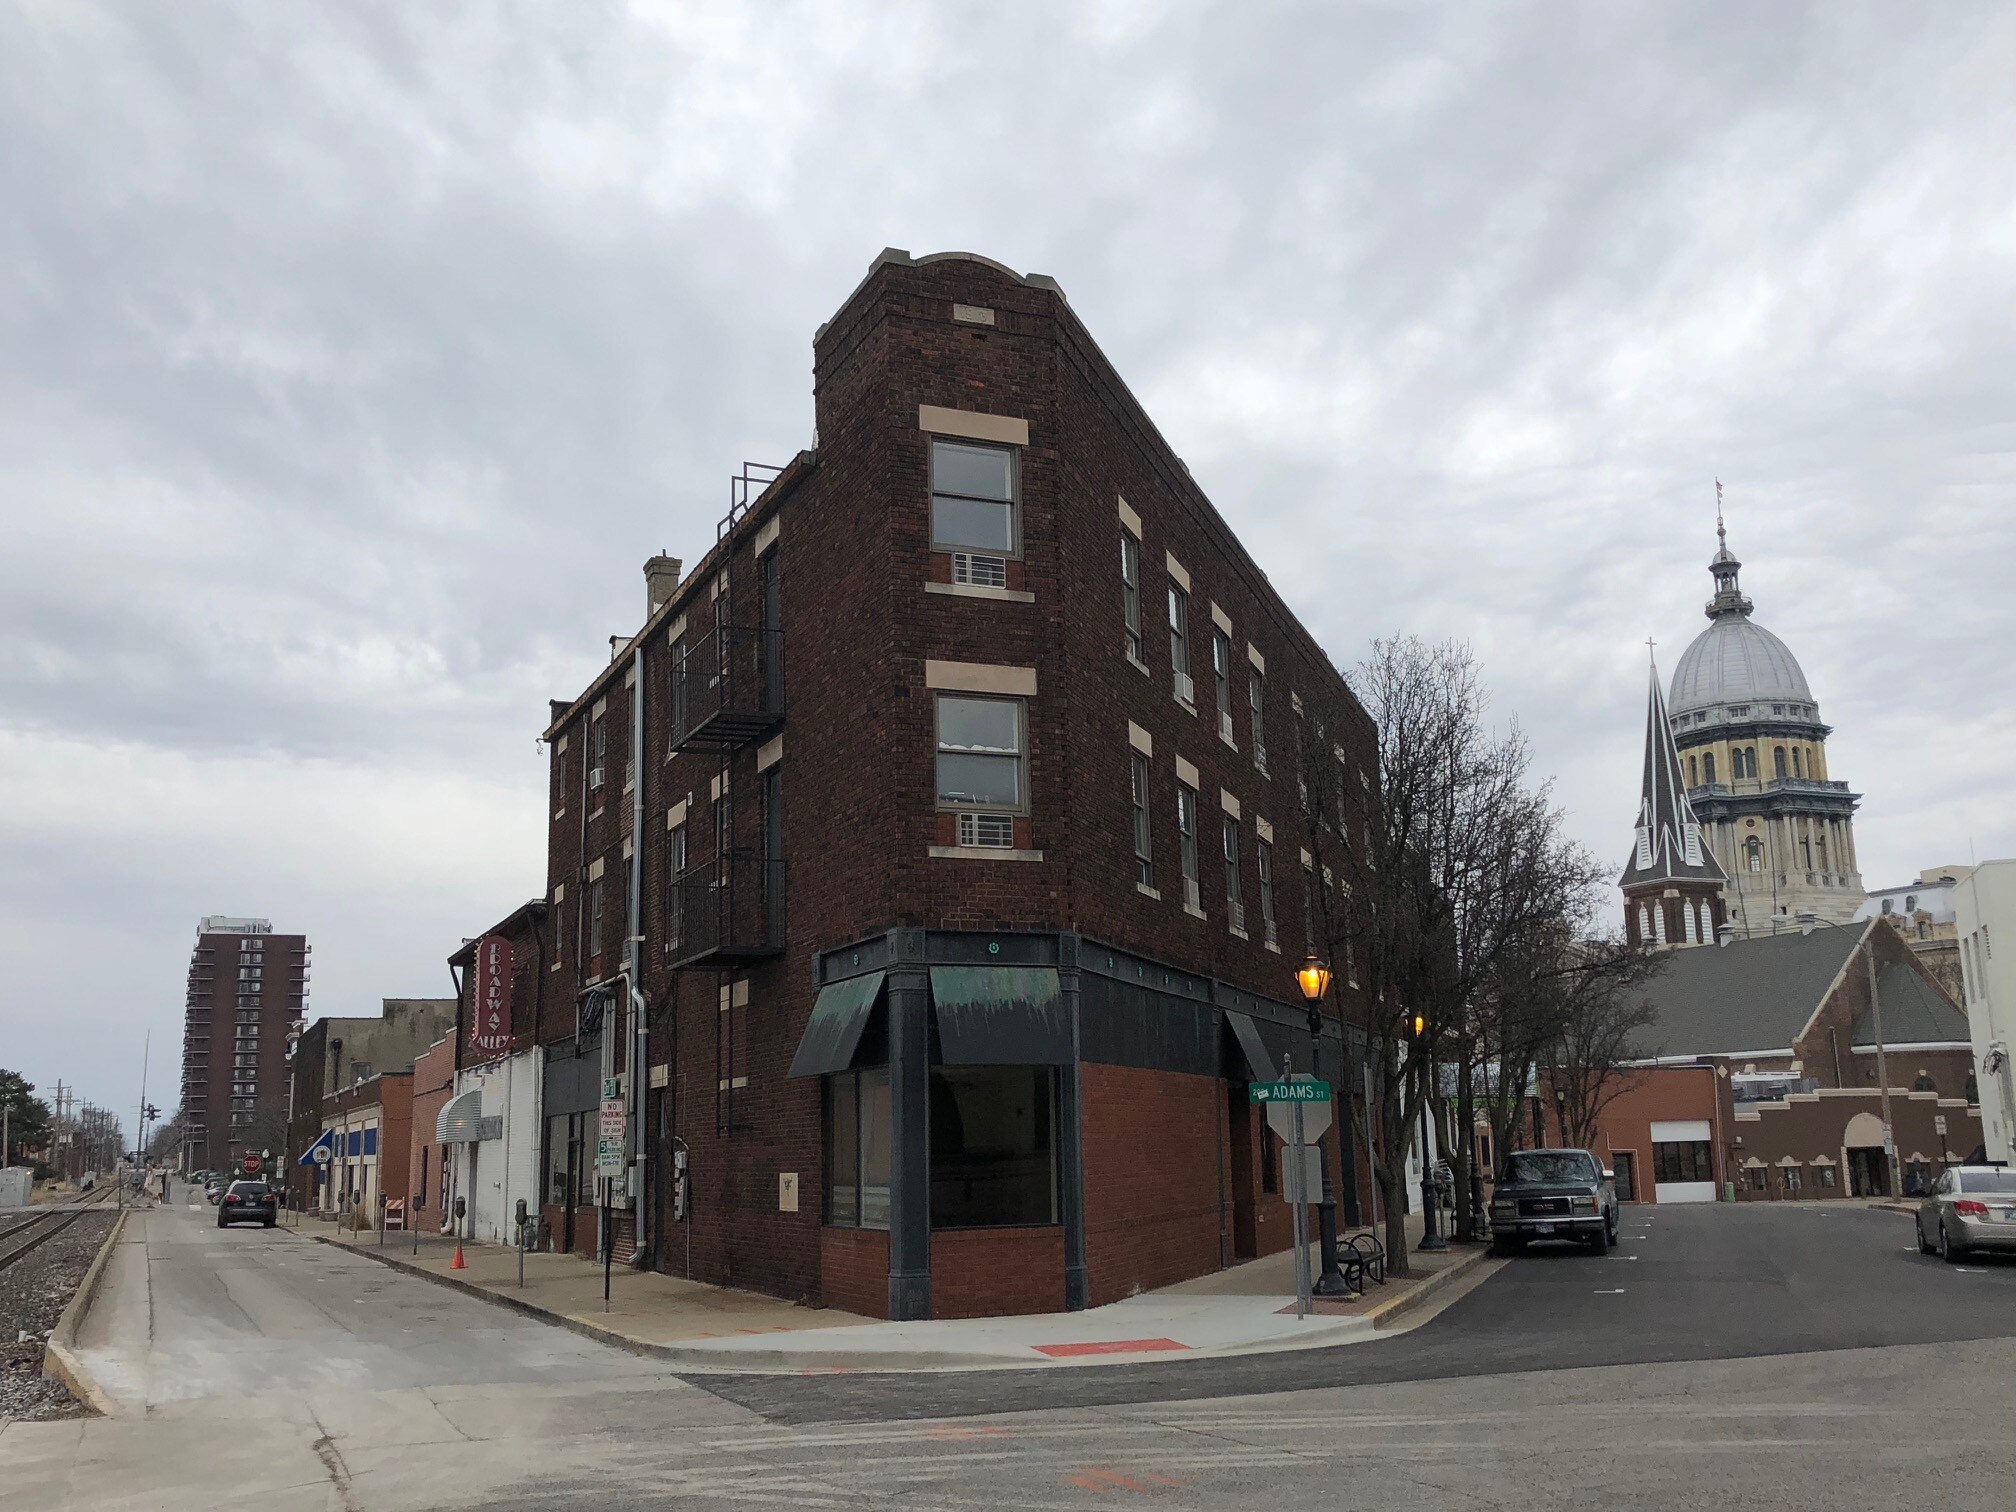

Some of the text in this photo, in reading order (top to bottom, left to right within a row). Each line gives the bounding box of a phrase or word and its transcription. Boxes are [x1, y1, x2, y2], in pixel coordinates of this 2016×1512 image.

[486, 943, 503, 1034] BROADWAY
[477, 1035, 509, 1049] ALLEY
[1272, 1085, 1314, 1099] ADAMS
[1315, 1090, 1324, 1099] ST
[600, 1142, 606, 1152] 5
[244, 1160, 259, 1168] STOP
